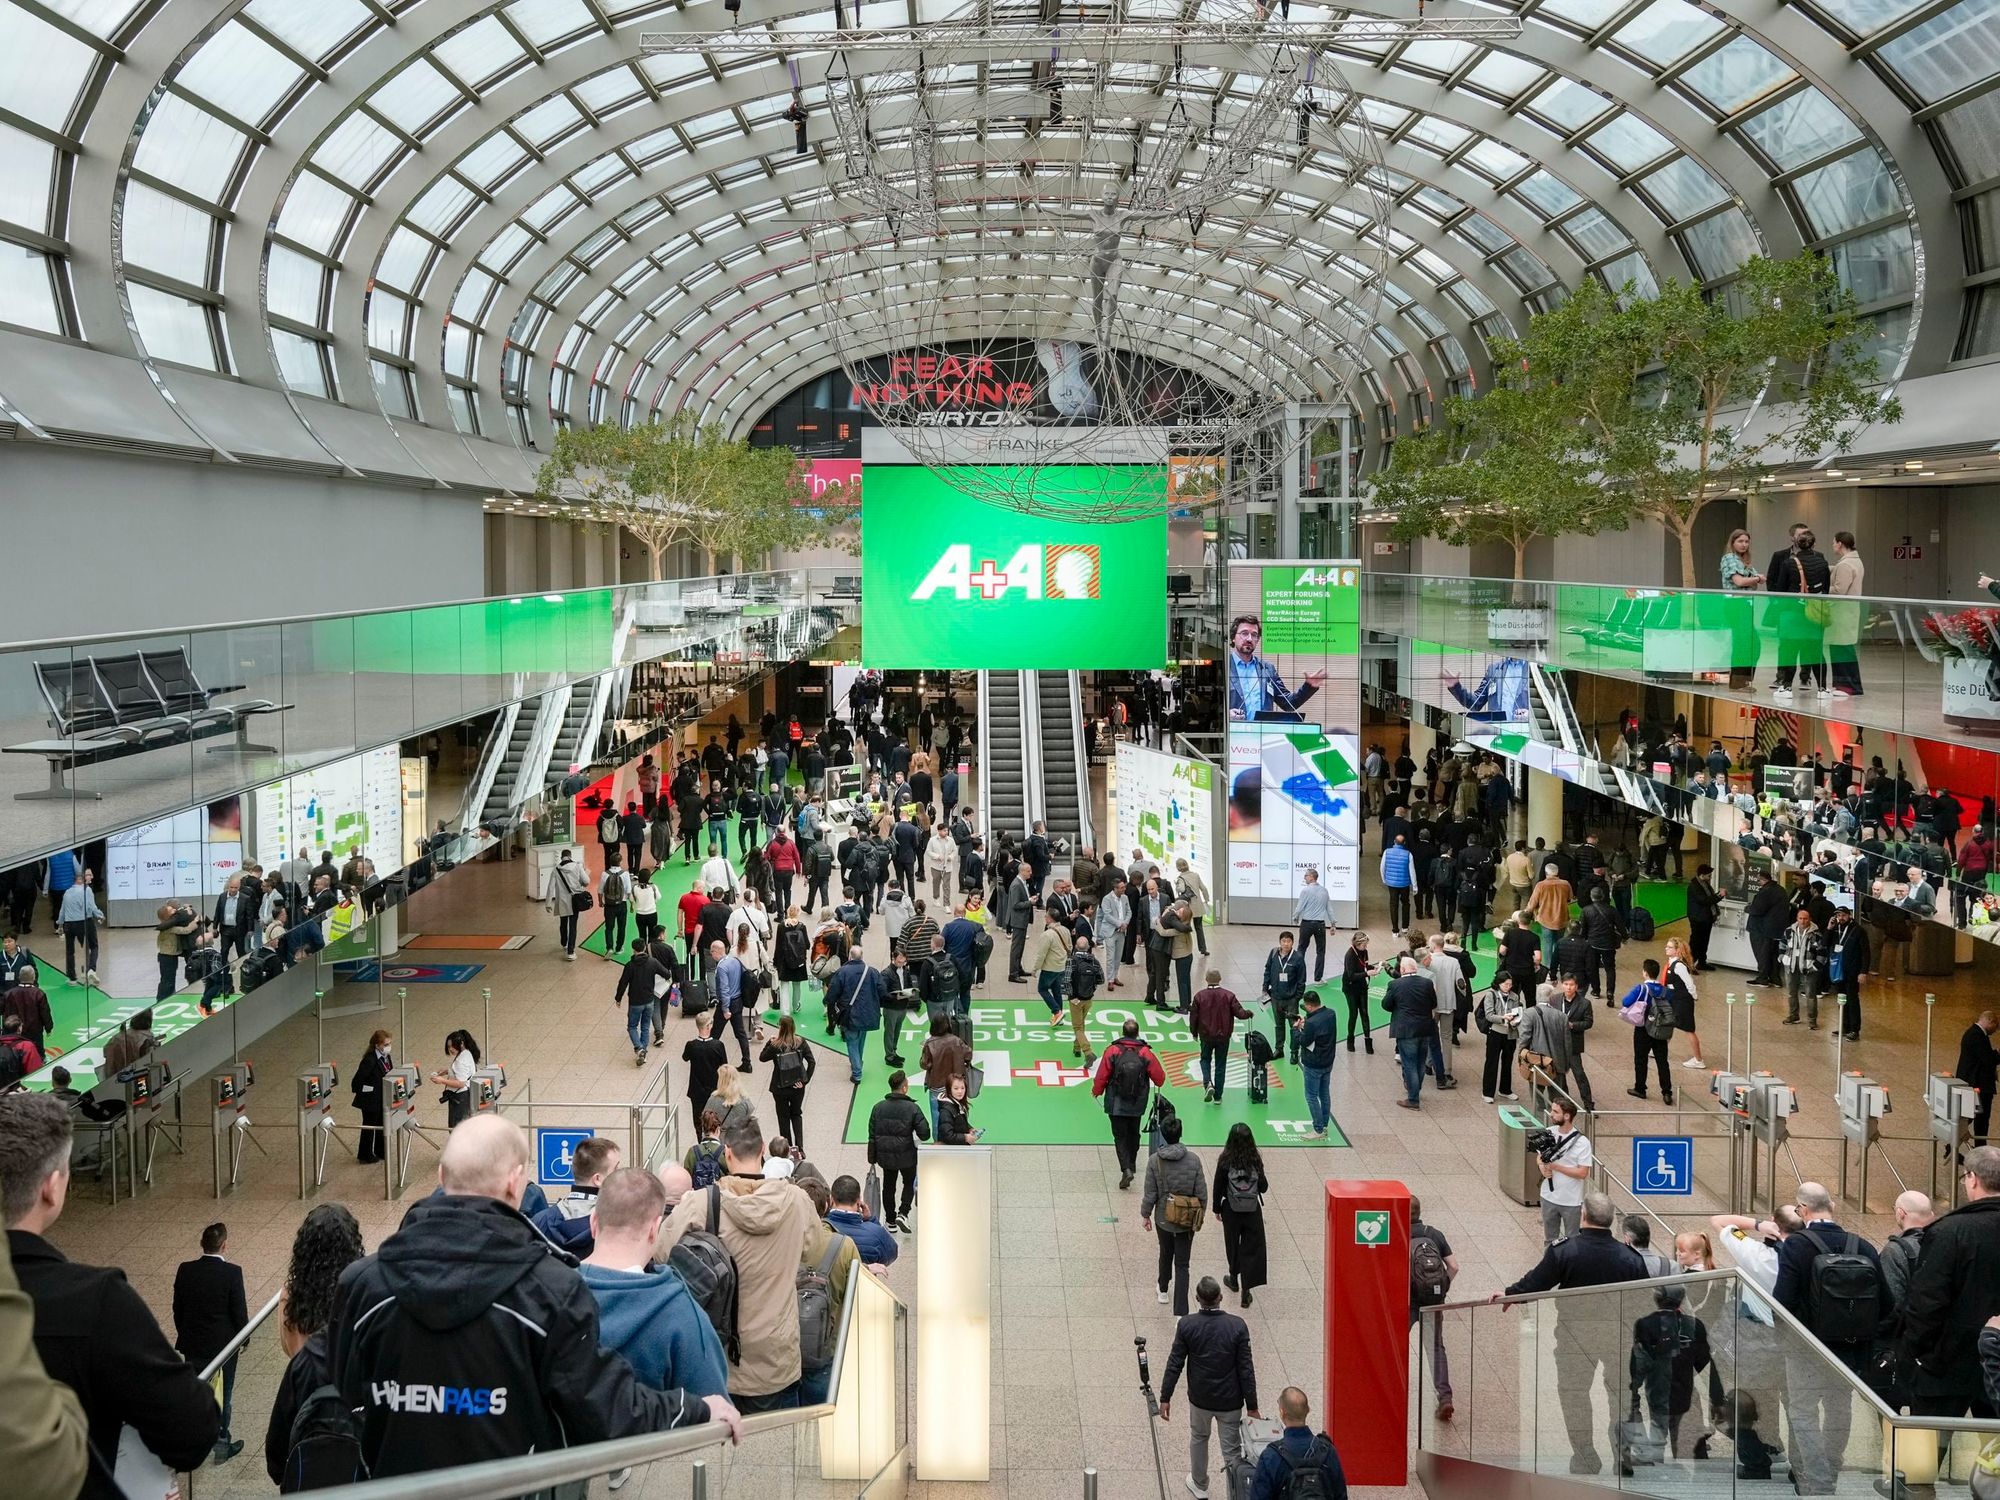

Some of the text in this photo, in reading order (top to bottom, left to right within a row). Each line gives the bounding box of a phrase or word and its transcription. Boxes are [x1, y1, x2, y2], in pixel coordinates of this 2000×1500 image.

[891, 356, 993, 379] FEAR
[852, 383, 1032, 406] NOTHING
[988, 439, 1063, 451] FRANKE
[910, 544, 1042, 600] A+A
[1295, 567, 1339, 587] A+A
[1507, 621, 1543, 629] Düsseldorf
[1231, 745, 1262, 754] Wear
[972, 1028, 1245, 1042] DÜSSELDOF
